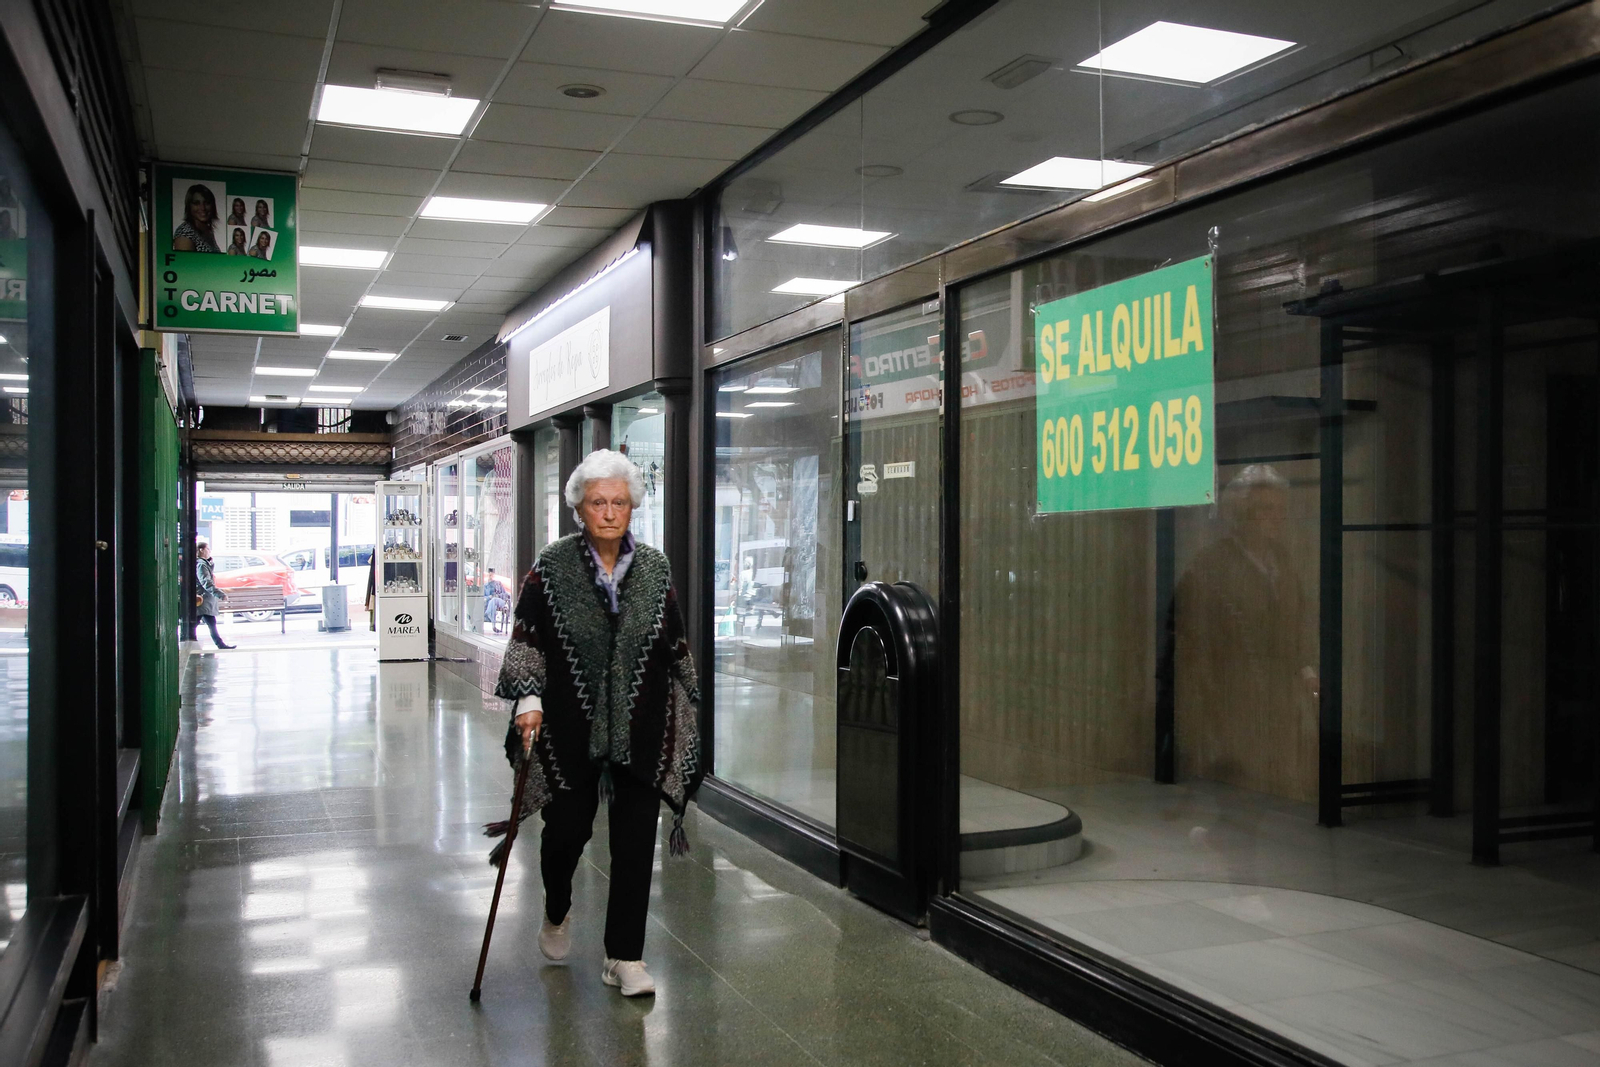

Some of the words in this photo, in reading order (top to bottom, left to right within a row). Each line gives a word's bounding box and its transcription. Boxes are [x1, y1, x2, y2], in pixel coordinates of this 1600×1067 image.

[163, 253, 178, 318] FOTO
[240, 267, 277, 283] مصور
[181, 289, 293, 315] CARNET
[1040, 319, 1071, 384] SE
[1077, 284, 1204, 377] ALQUILA
[1042, 413, 1084, 479] 600
[1091, 405, 1140, 474] 512
[1148, 394, 1203, 469] 058
[387, 626, 421, 634] MAREA
